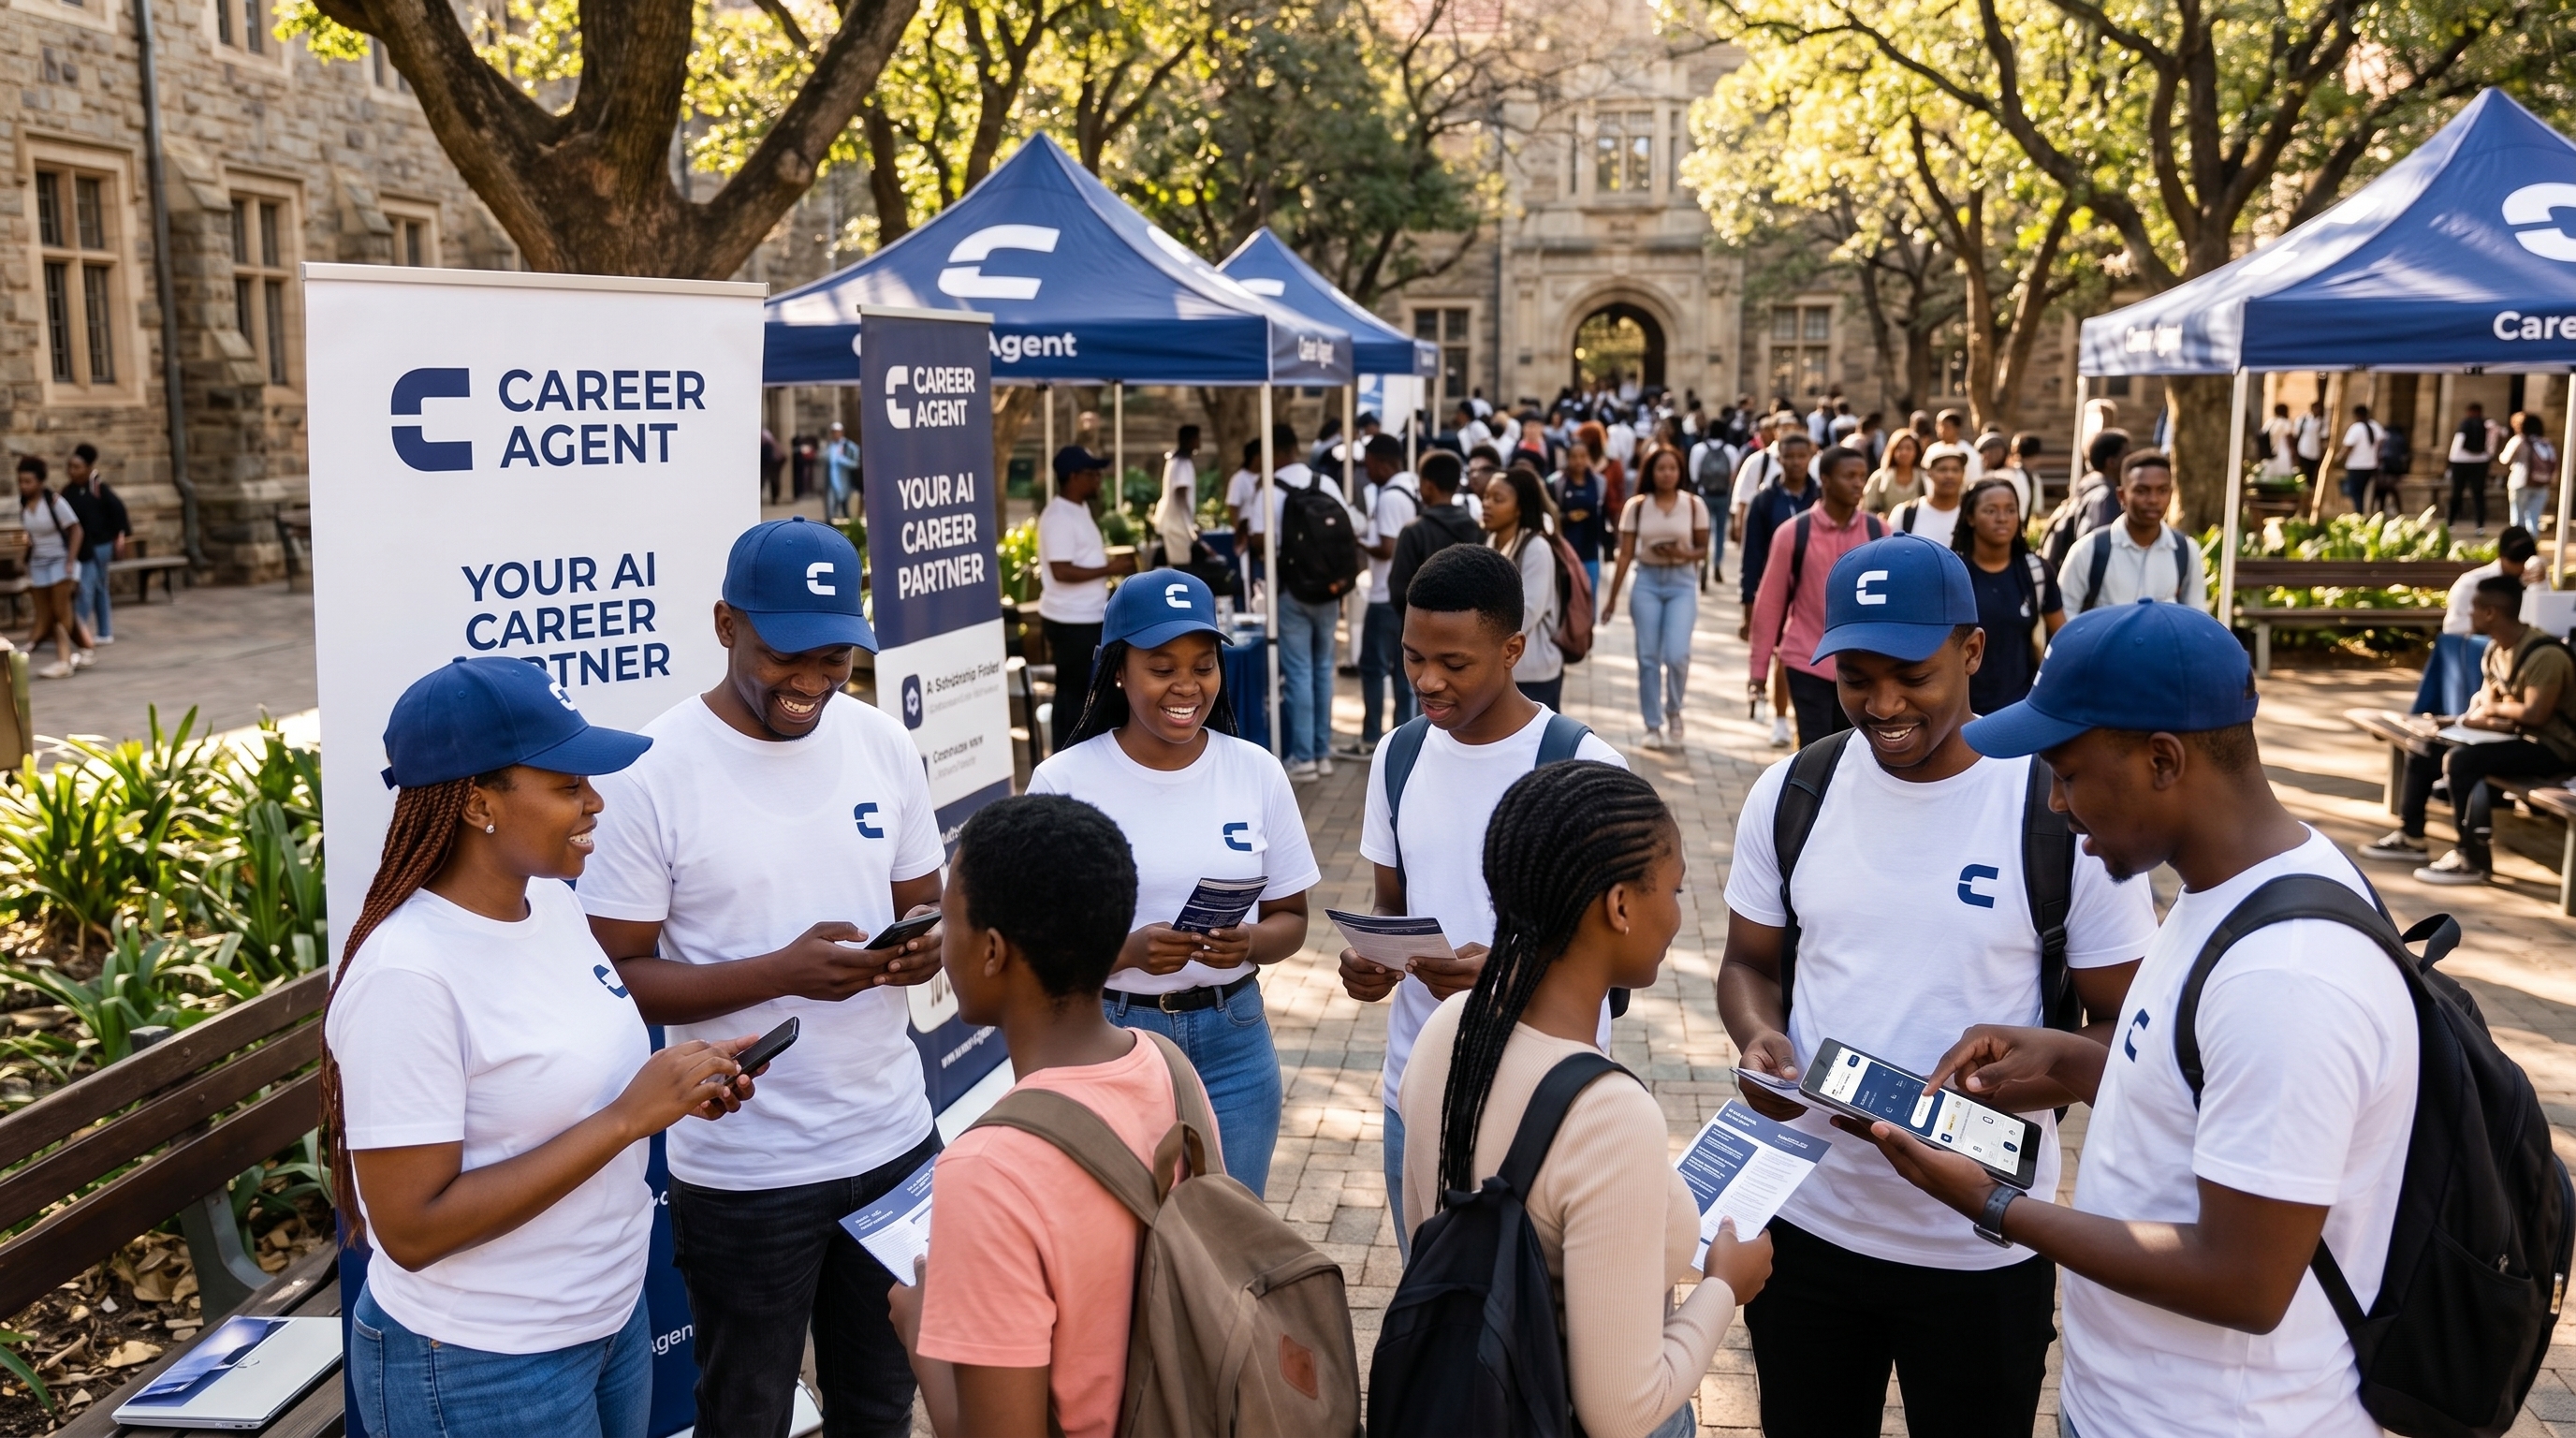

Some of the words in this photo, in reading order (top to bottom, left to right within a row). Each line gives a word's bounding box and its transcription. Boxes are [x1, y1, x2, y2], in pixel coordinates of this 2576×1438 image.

[988, 330, 1077, 363] Agent
[2494, 311, 2576, 341] Care
[499, 368, 706, 412] CAREER
[914, 366, 976, 394] CAREER
[915, 399, 968, 428] AGENT
[499, 422, 679, 469] AGENT
[897, 475, 952, 511] YOUR
[955, 472, 975, 504] AI
[901, 513, 977, 554] CAREER
[461, 556, 598, 602] YOUR
[611, 551, 655, 590] AI
[898, 552, 985, 600] PARTNER
[465, 598, 656, 651] CAREER
[520, 642, 670, 688] TNER
[651, 1324, 694, 1356] gen
